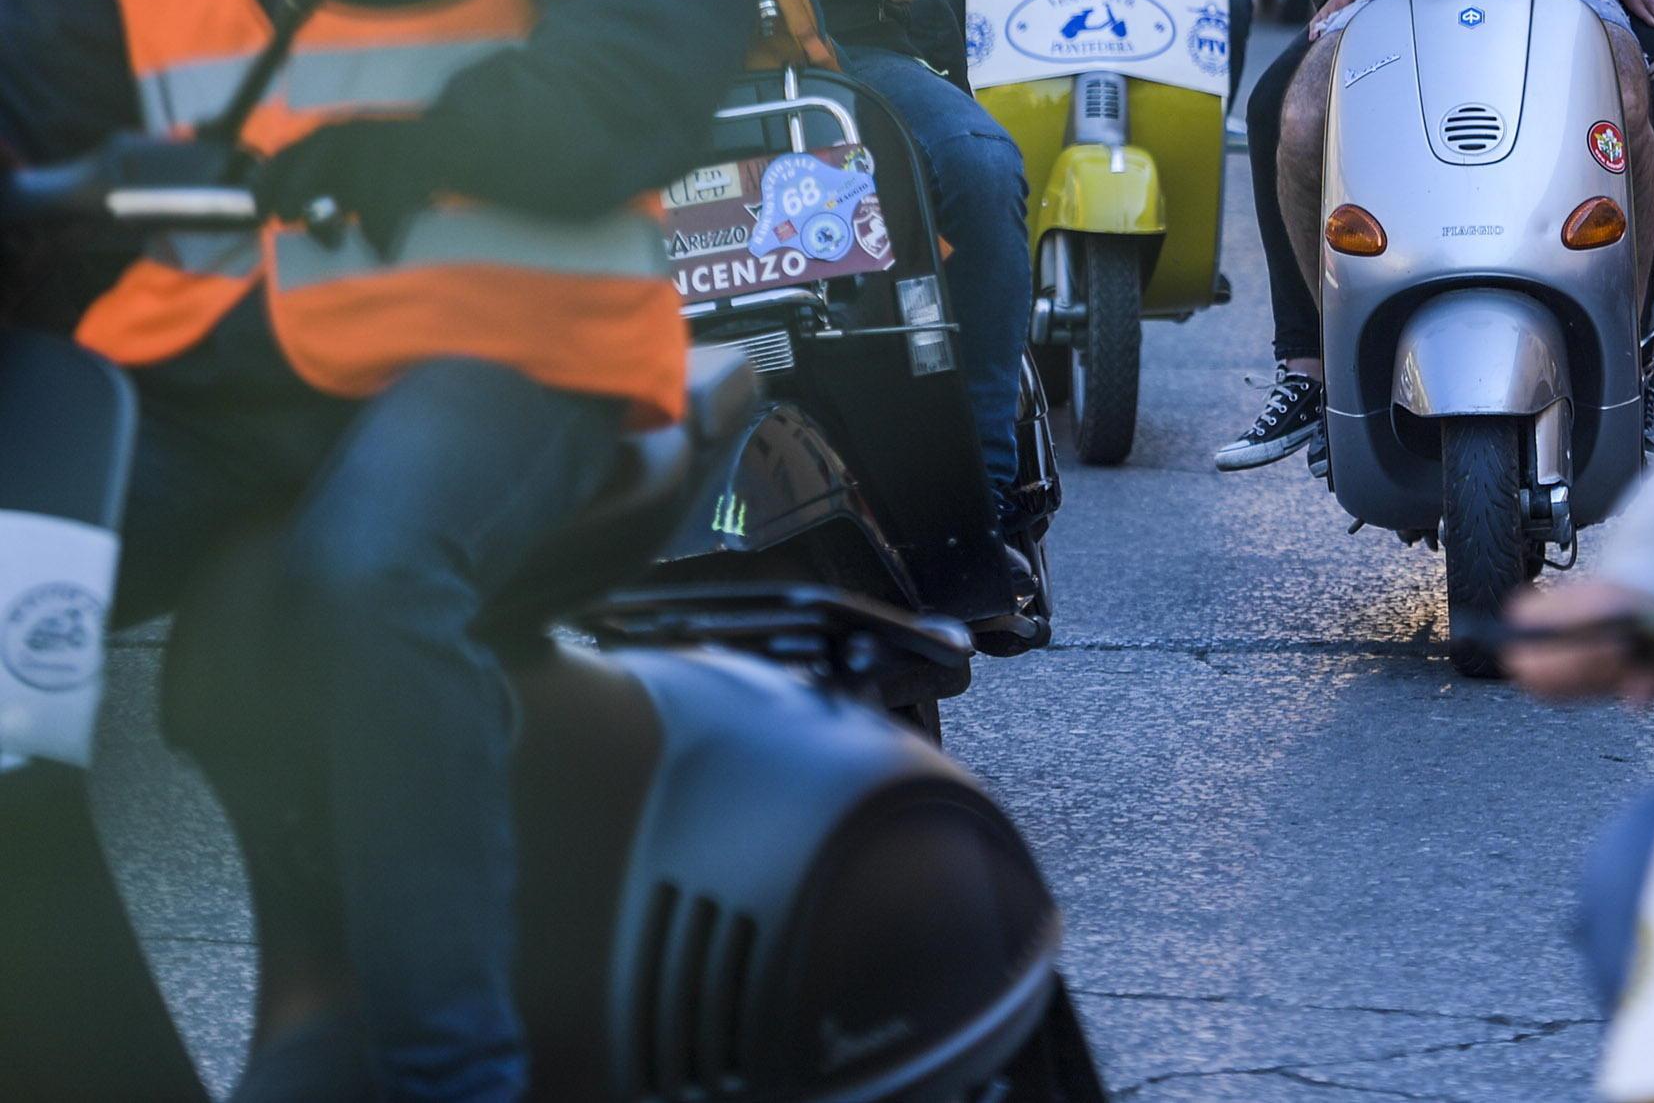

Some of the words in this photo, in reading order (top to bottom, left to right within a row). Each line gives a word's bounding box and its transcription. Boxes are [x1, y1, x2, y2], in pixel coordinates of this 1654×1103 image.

[782, 177, 821, 216] 68
[1442, 225, 1504, 237] PIAGGIO
[672, 251, 805, 295] NCENZO
